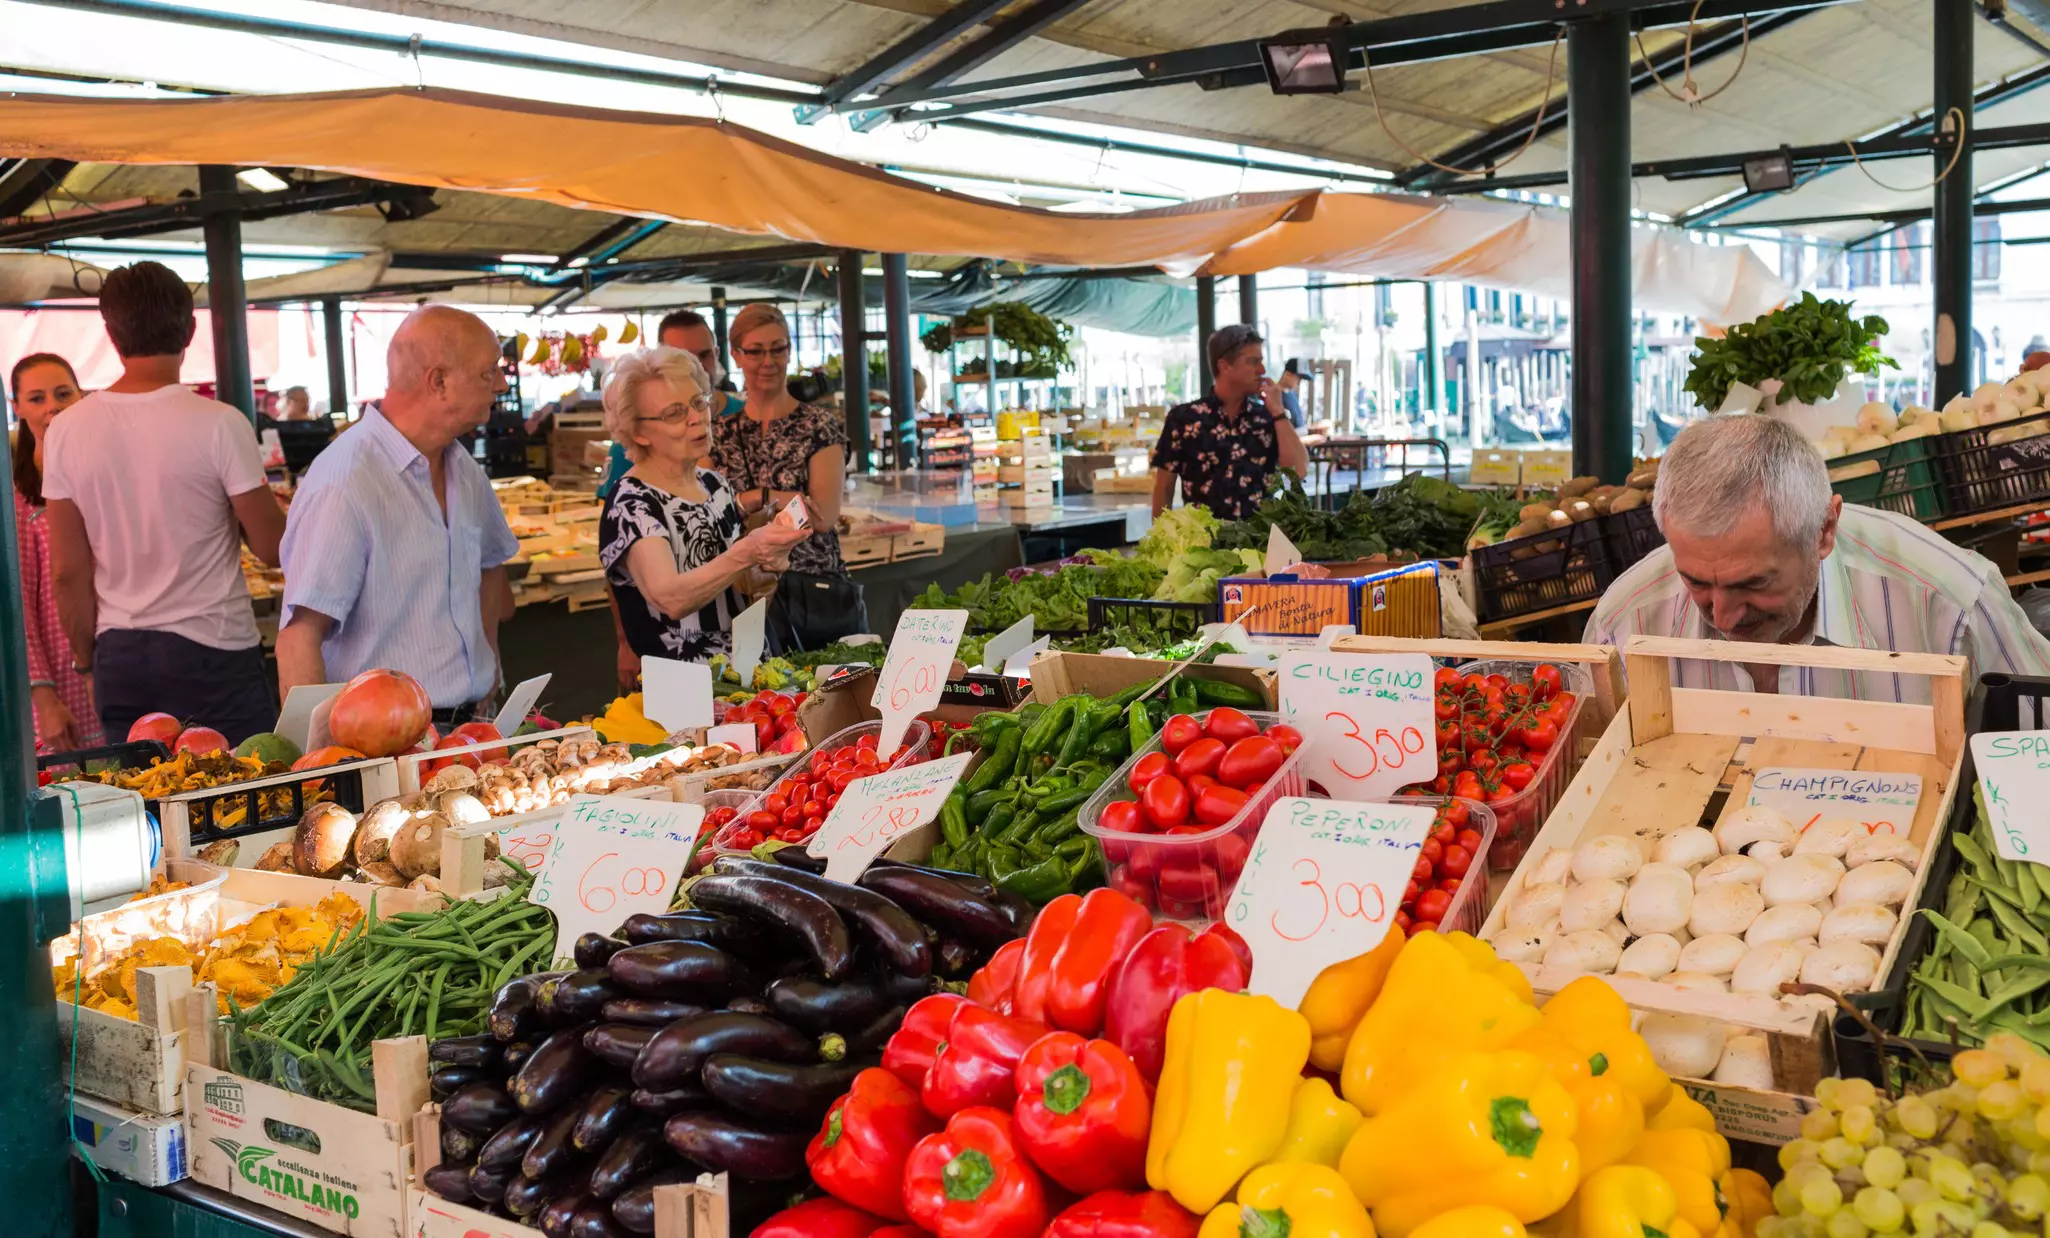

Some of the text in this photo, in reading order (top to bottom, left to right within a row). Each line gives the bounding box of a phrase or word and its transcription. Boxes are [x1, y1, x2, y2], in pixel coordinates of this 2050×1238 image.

[1292, 663, 1424, 690] CILIEGINO
[1338, 687, 1361, 695] CAT
[1753, 772, 1919, 795] CHAMPIGNONS
[1805, 793, 1827, 801] CAT
[572, 799, 680, 830] FAGIOLINI
[1291, 800, 1412, 832] PEPERONI
[1271, 858, 1385, 942] 3.00
[1718, 1105, 1778, 1124] BISPORUS
[241, 1157, 360, 1220] CATALANO
